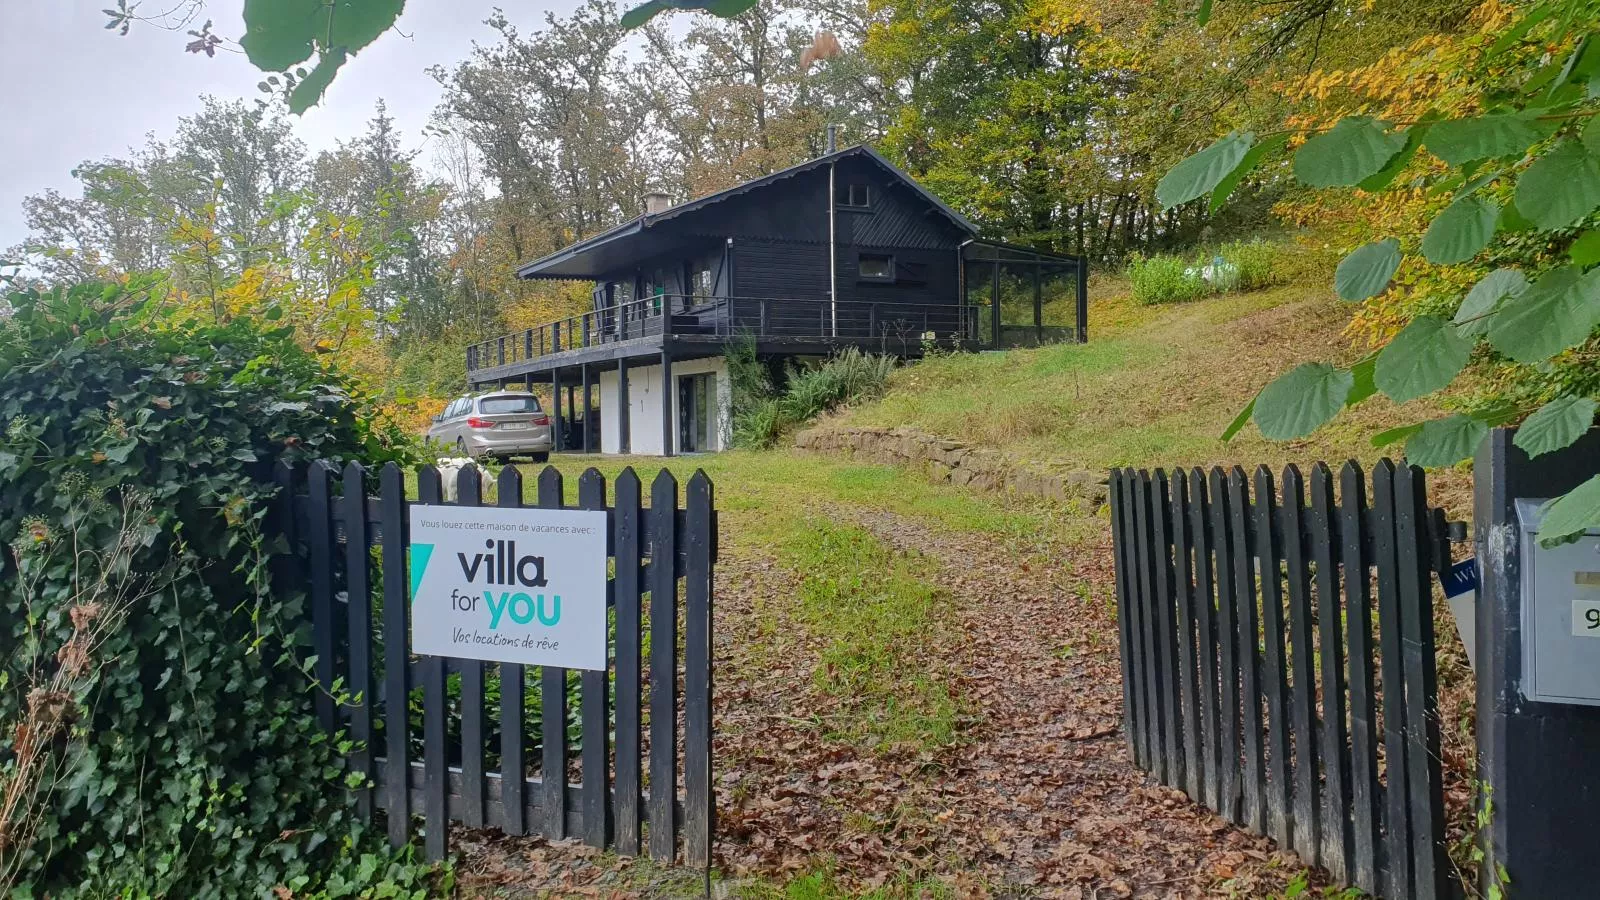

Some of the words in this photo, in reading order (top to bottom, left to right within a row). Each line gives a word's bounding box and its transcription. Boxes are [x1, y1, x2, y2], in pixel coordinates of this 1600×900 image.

[420, 519, 440, 529] Vous
[441, 520, 463, 530] louez
[464, 521, 485, 531] cette
[486, 522, 517, 532] maison
[518, 523, 529, 532] de
[531, 524, 569, 534] vacances
[457, 538, 548, 587] villa
[451, 589, 480, 611] for
[483, 590, 561, 629] you
[1585, 608, 1600, 629] 9
[453, 627, 471, 644] Vos
[472, 629, 520, 648] locations
[521, 634, 534, 649] de
[536, 636, 559, 651] rêve
